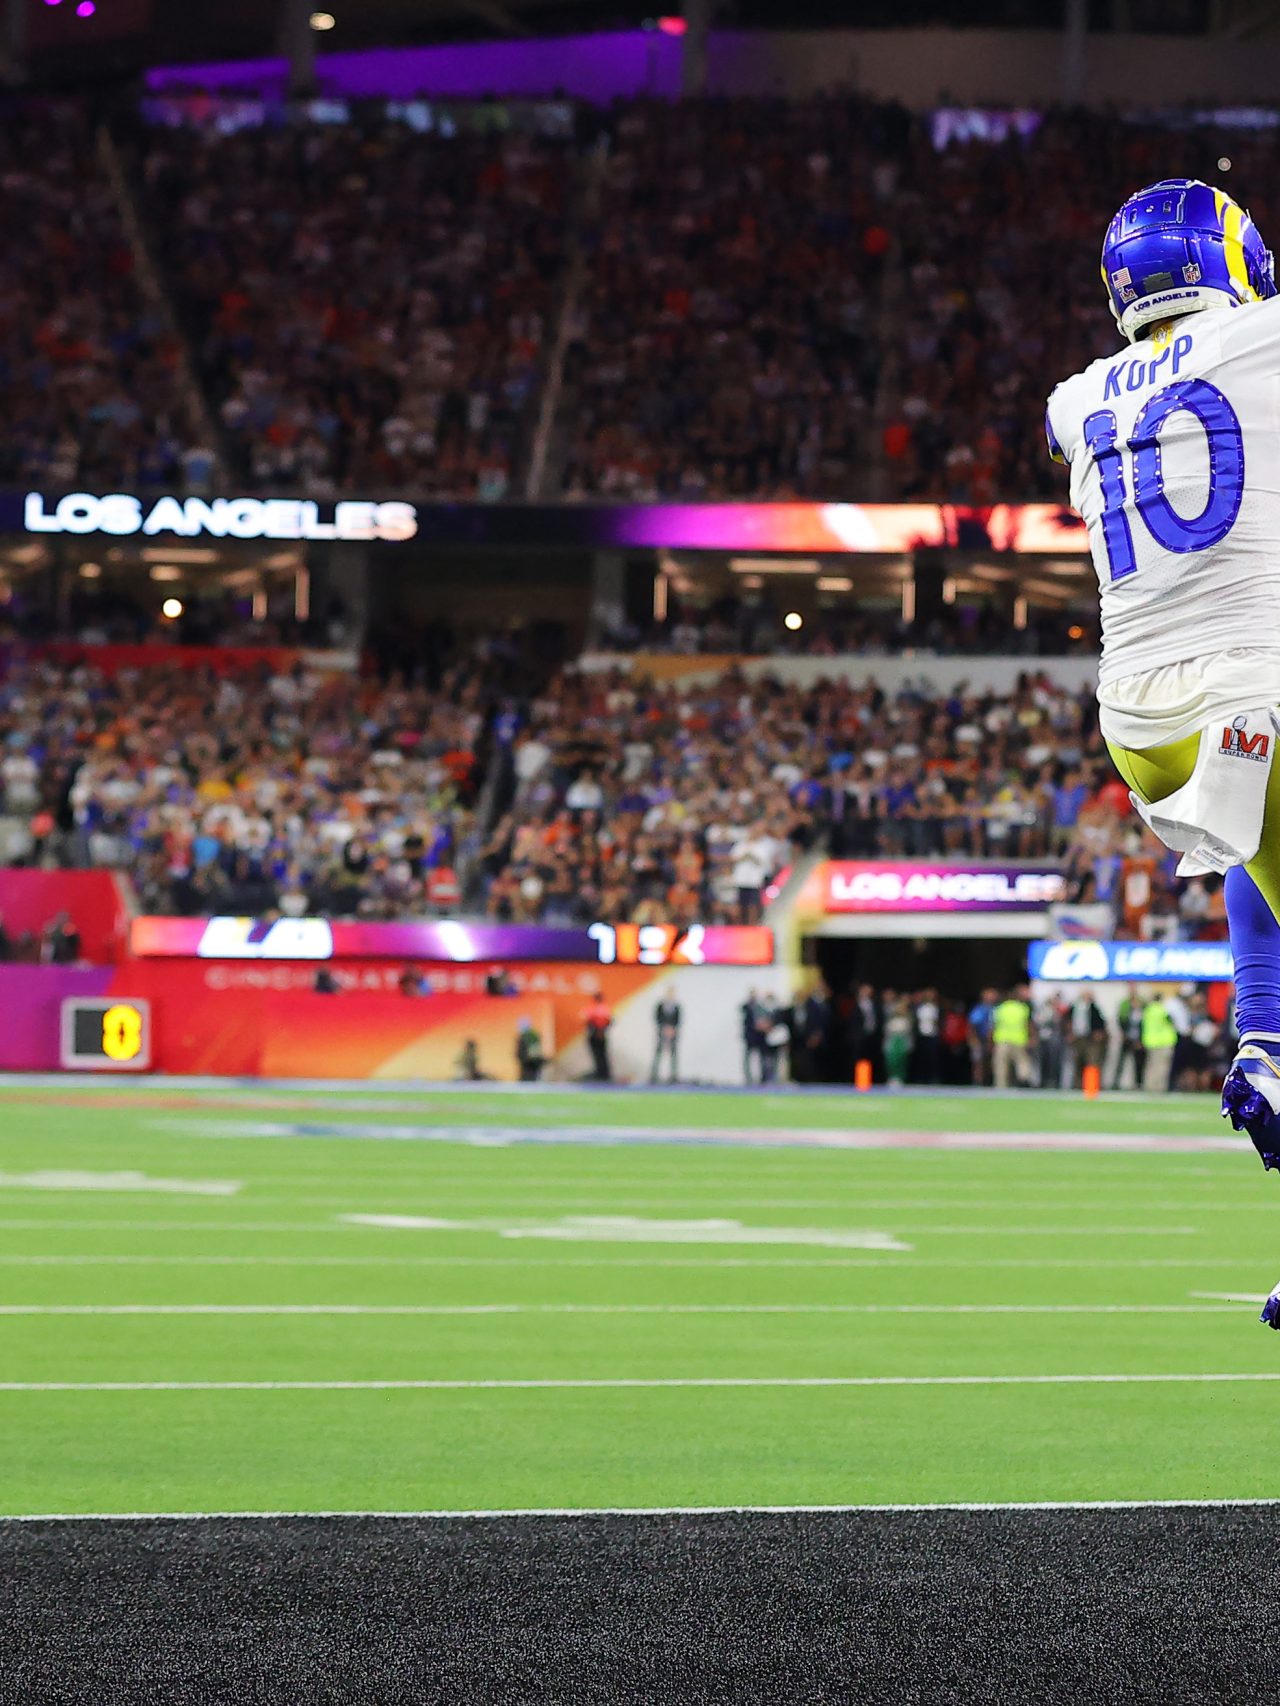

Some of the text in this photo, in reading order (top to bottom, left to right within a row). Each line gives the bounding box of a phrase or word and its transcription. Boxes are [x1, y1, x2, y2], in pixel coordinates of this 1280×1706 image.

[1133, 291, 1200, 312] LOS ANGELES
[1103, 334, 1193, 402] KUPP
[1083, 378, 1245, 582] 10
[24, 492, 418, 541] LOS ANGELES
[831, 872, 1067, 902] LOS ANGELES
